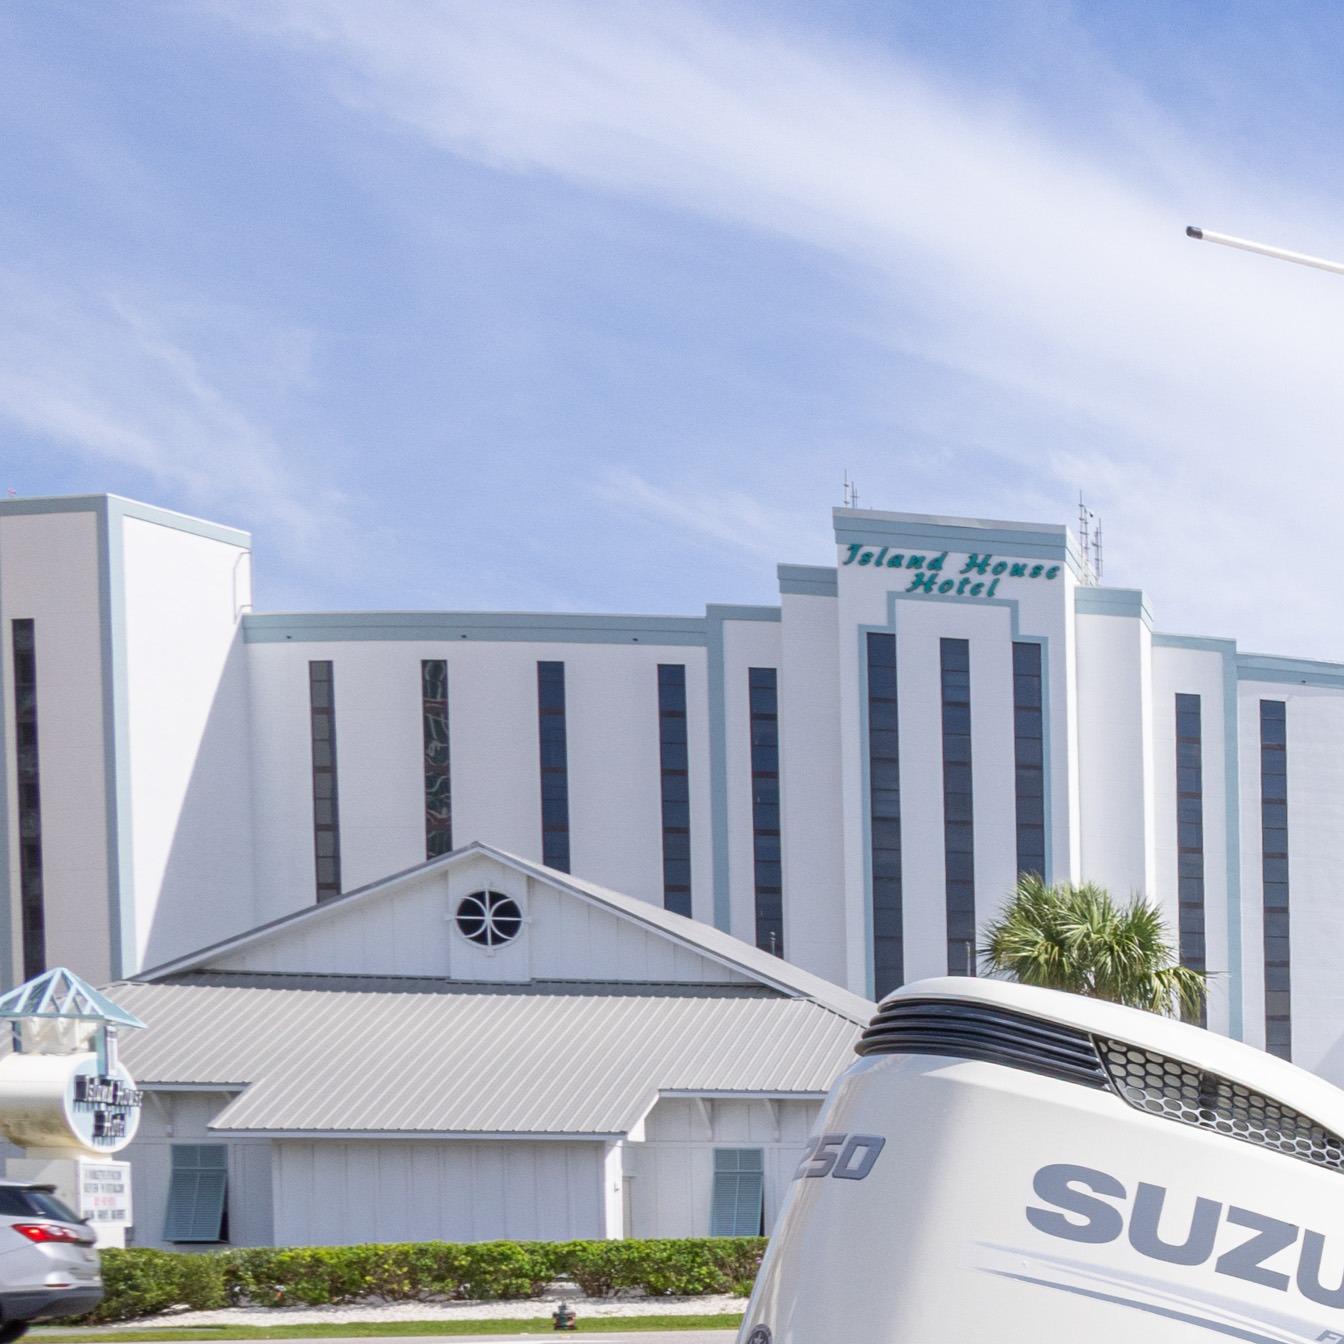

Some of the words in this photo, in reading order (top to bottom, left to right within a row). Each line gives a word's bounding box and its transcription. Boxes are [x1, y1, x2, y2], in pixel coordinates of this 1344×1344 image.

[843, 543, 949, 572] Island
[959, 552, 1061, 580] House
[905, 571, 1001, 598] Hotel
